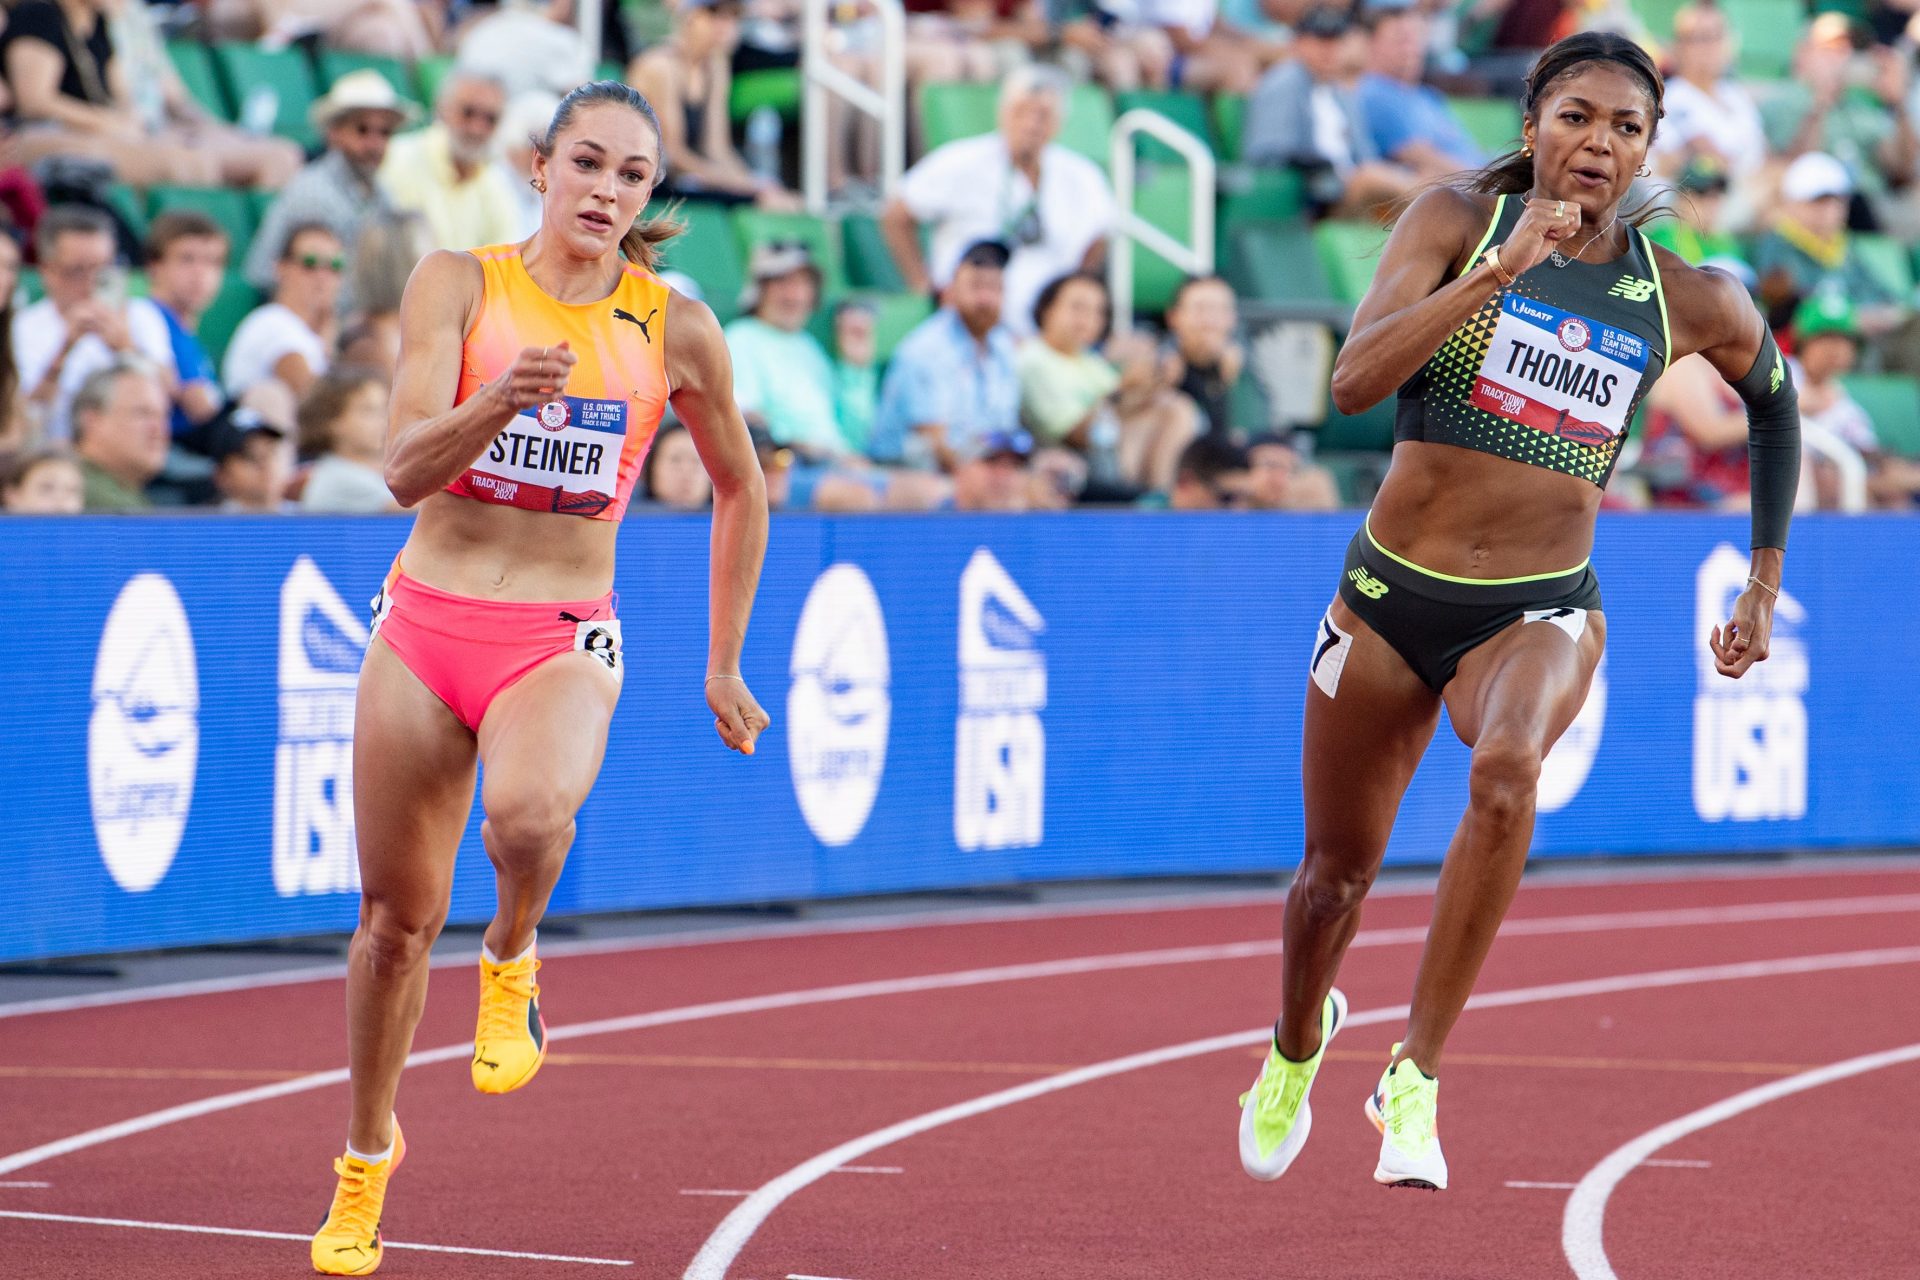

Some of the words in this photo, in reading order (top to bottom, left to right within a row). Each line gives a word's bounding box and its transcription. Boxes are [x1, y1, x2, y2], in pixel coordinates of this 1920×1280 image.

[1524, 307, 1553, 321] USATF
[1601, 337, 1619, 349] TEAM
[1620, 344, 1642, 358] TRIALS
[1603, 329, 1615, 340] U.S.
[1617, 334, 1643, 350] OLYMPIC
[1600, 345, 1614, 355] TRACK
[1506, 339, 1618, 408] THOMAS
[1480, 383, 1527, 409] TRACKTOWN
[582, 411, 599, 420] TEAM
[600, 412, 621, 421] TRIALS
[583, 402, 595, 411] U.S.
[596, 403, 621, 413] OLYMPIC
[1500, 401, 1521, 416] 2024
[489, 431, 604, 475] STEINER
[472, 475, 518, 493] TRACKTOWN
[494, 489, 514, 501] 2024
[1311, 613, 1341, 664] 7
